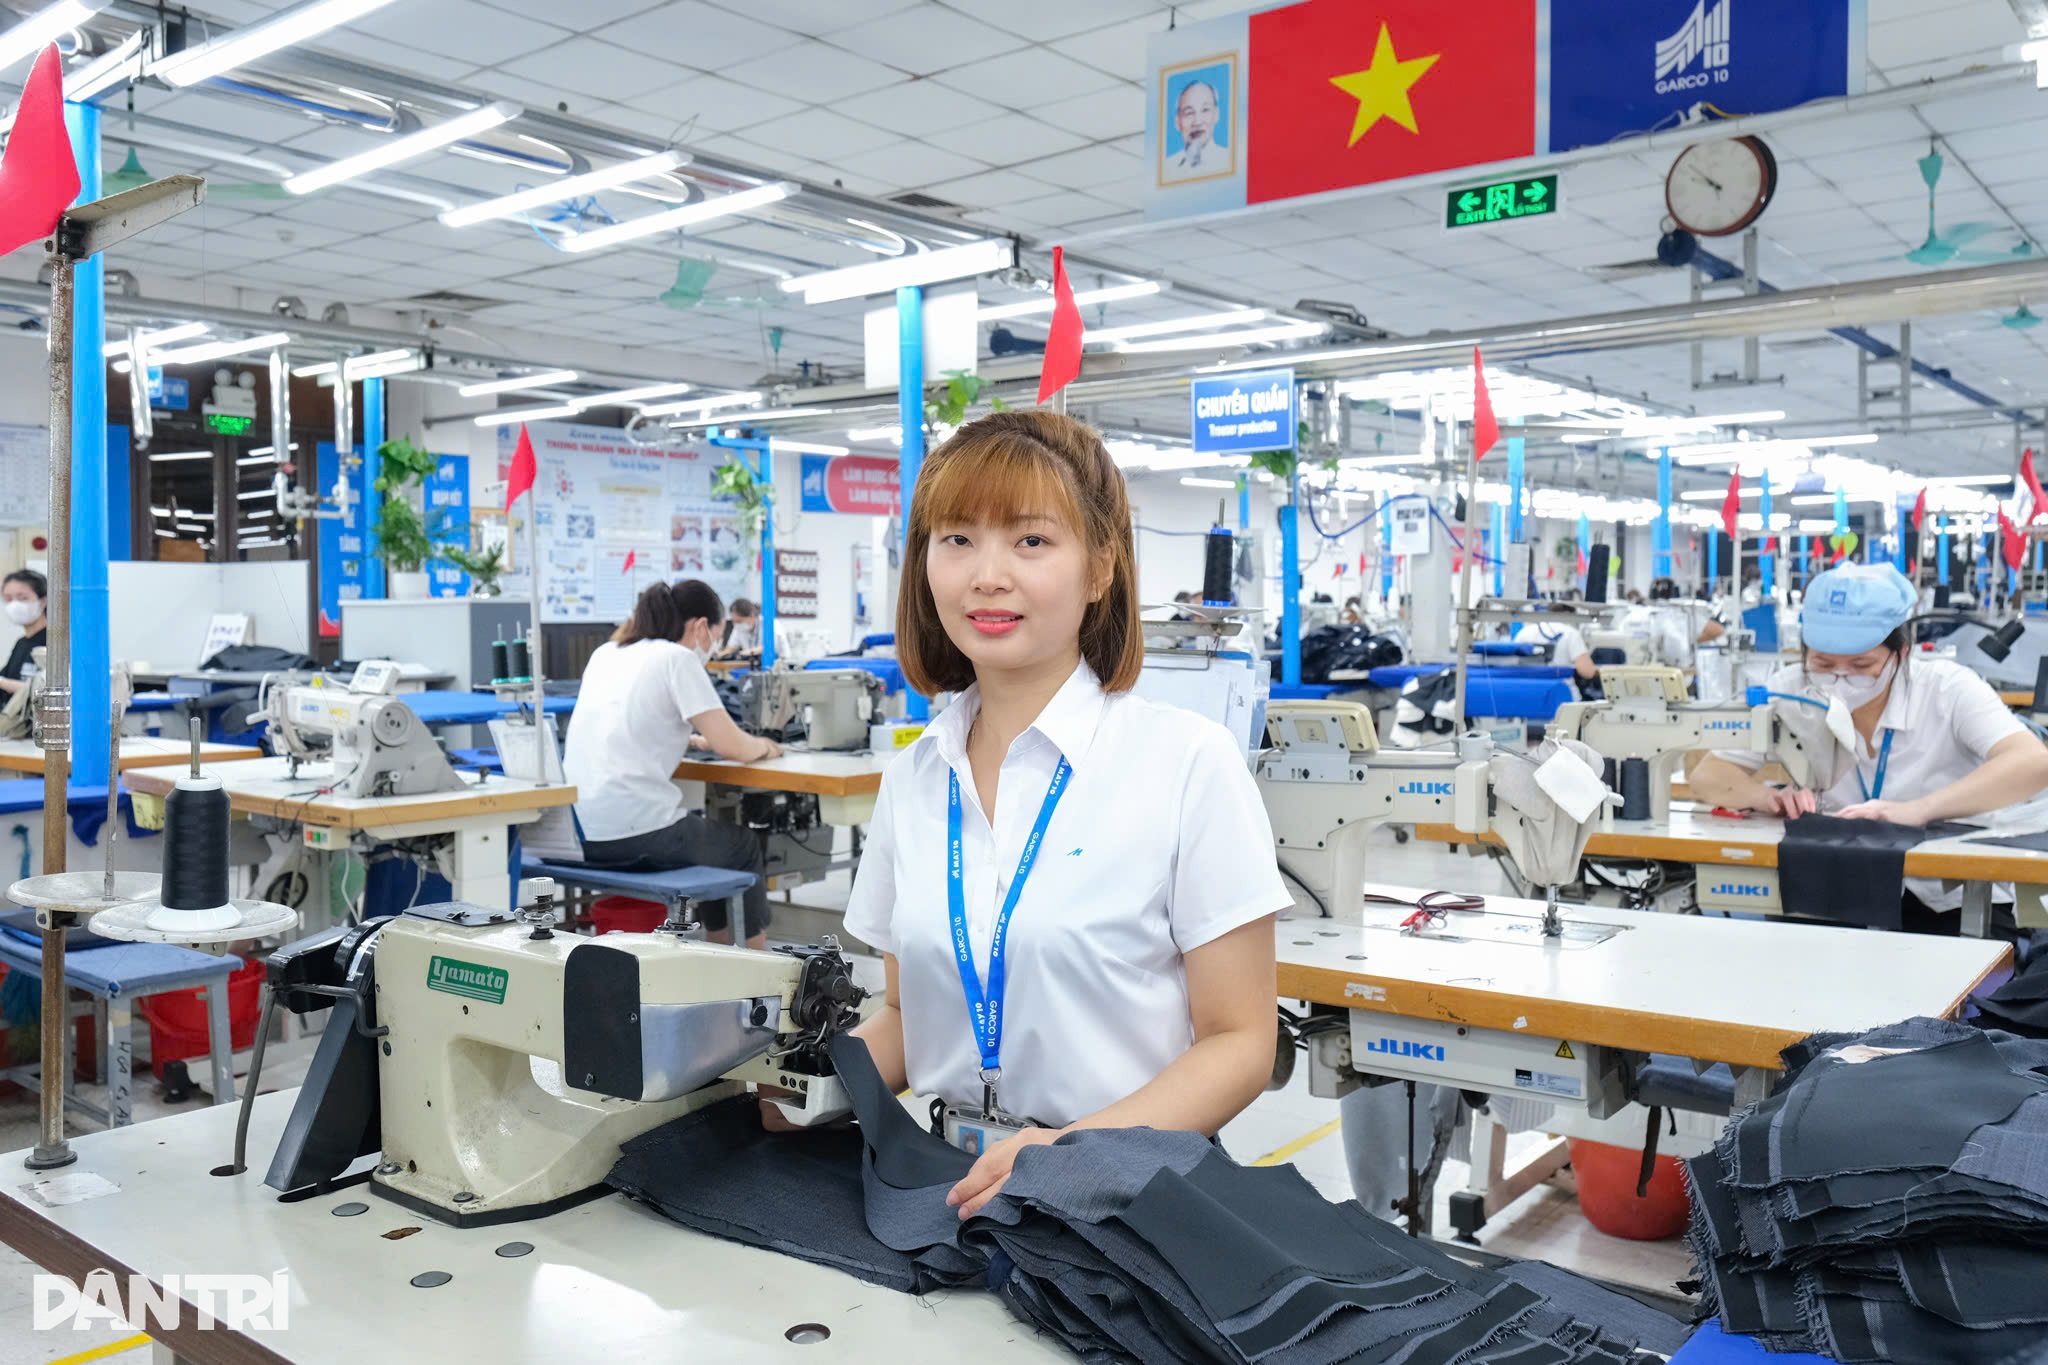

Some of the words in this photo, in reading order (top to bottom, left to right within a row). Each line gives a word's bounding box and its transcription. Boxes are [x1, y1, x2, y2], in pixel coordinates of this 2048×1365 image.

[1655, 72, 1709, 94] GARCO
[1713, 68, 1729, 84] 10
[1456, 209, 1486, 224] EXIT
[1704, 720, 1751, 730] JUKI
[1054, 766, 1065, 786] MAY
[1049, 785, 1058, 795] 10
[953, 840, 959, 849] 10
[1023, 832, 1039, 863] GARCO
[1018, 865, 1027, 874] 10
[1711, 884, 1769, 897] JUKI
[954, 916, 962, 927] 10
[994, 925, 1003, 947] MAY
[956, 928, 968, 962] GARCO
[992, 948, 999, 957] 10
[433, 959, 505, 989] Yamato
[975, 1002, 984, 1012] 10
[988, 1000, 998, 1034] GARCO
[987, 1038, 995, 1047] 10
[1368, 1038, 1445, 1061] JUKI
